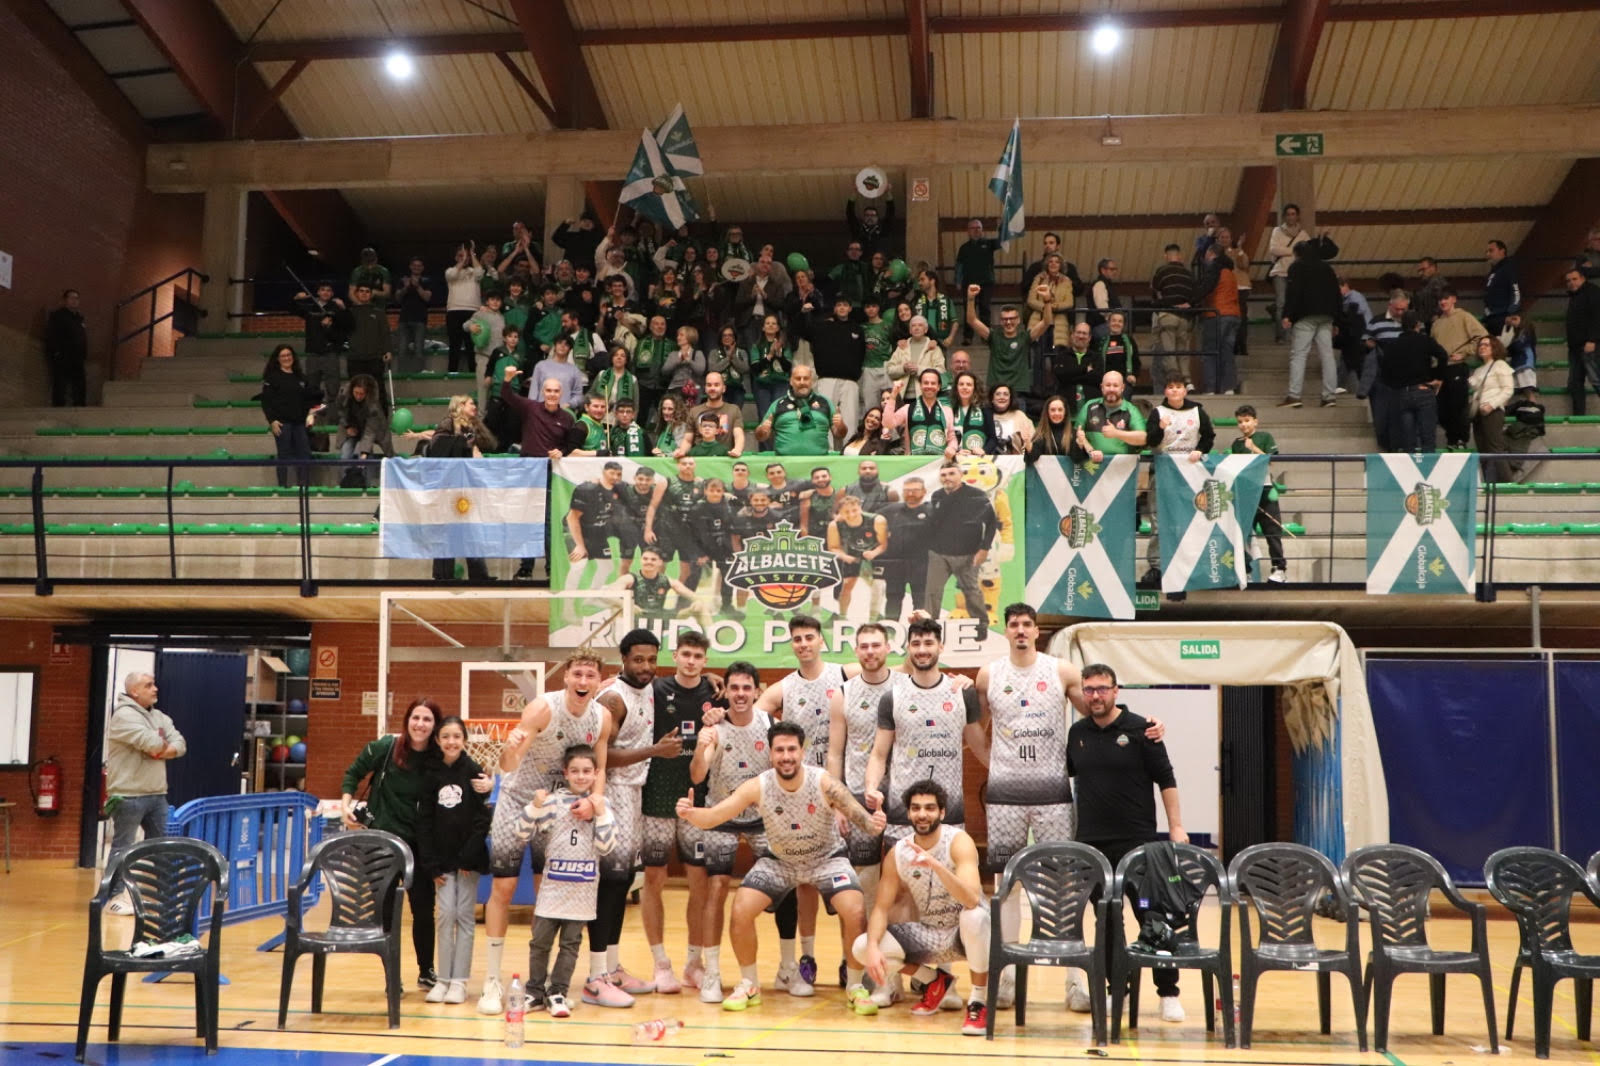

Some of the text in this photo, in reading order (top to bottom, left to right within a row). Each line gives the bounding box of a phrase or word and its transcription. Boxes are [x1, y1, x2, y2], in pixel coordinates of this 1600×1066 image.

[1075, 508, 1086, 547] ALBACETE
[735, 553, 833, 575] ALBACETE
[1208, 539, 1219, 584] Globalcaja
[1416, 545, 1427, 589] Globalcaja
[744, 574, 824, 585] BASKET
[1064, 567, 1077, 611] Globalcaja
[1136, 595, 1157, 605] LIDA
[1182, 644, 1218, 655] SALIDA
[1019, 745, 1036, 762] 44
[570, 829, 578, 846] 6
